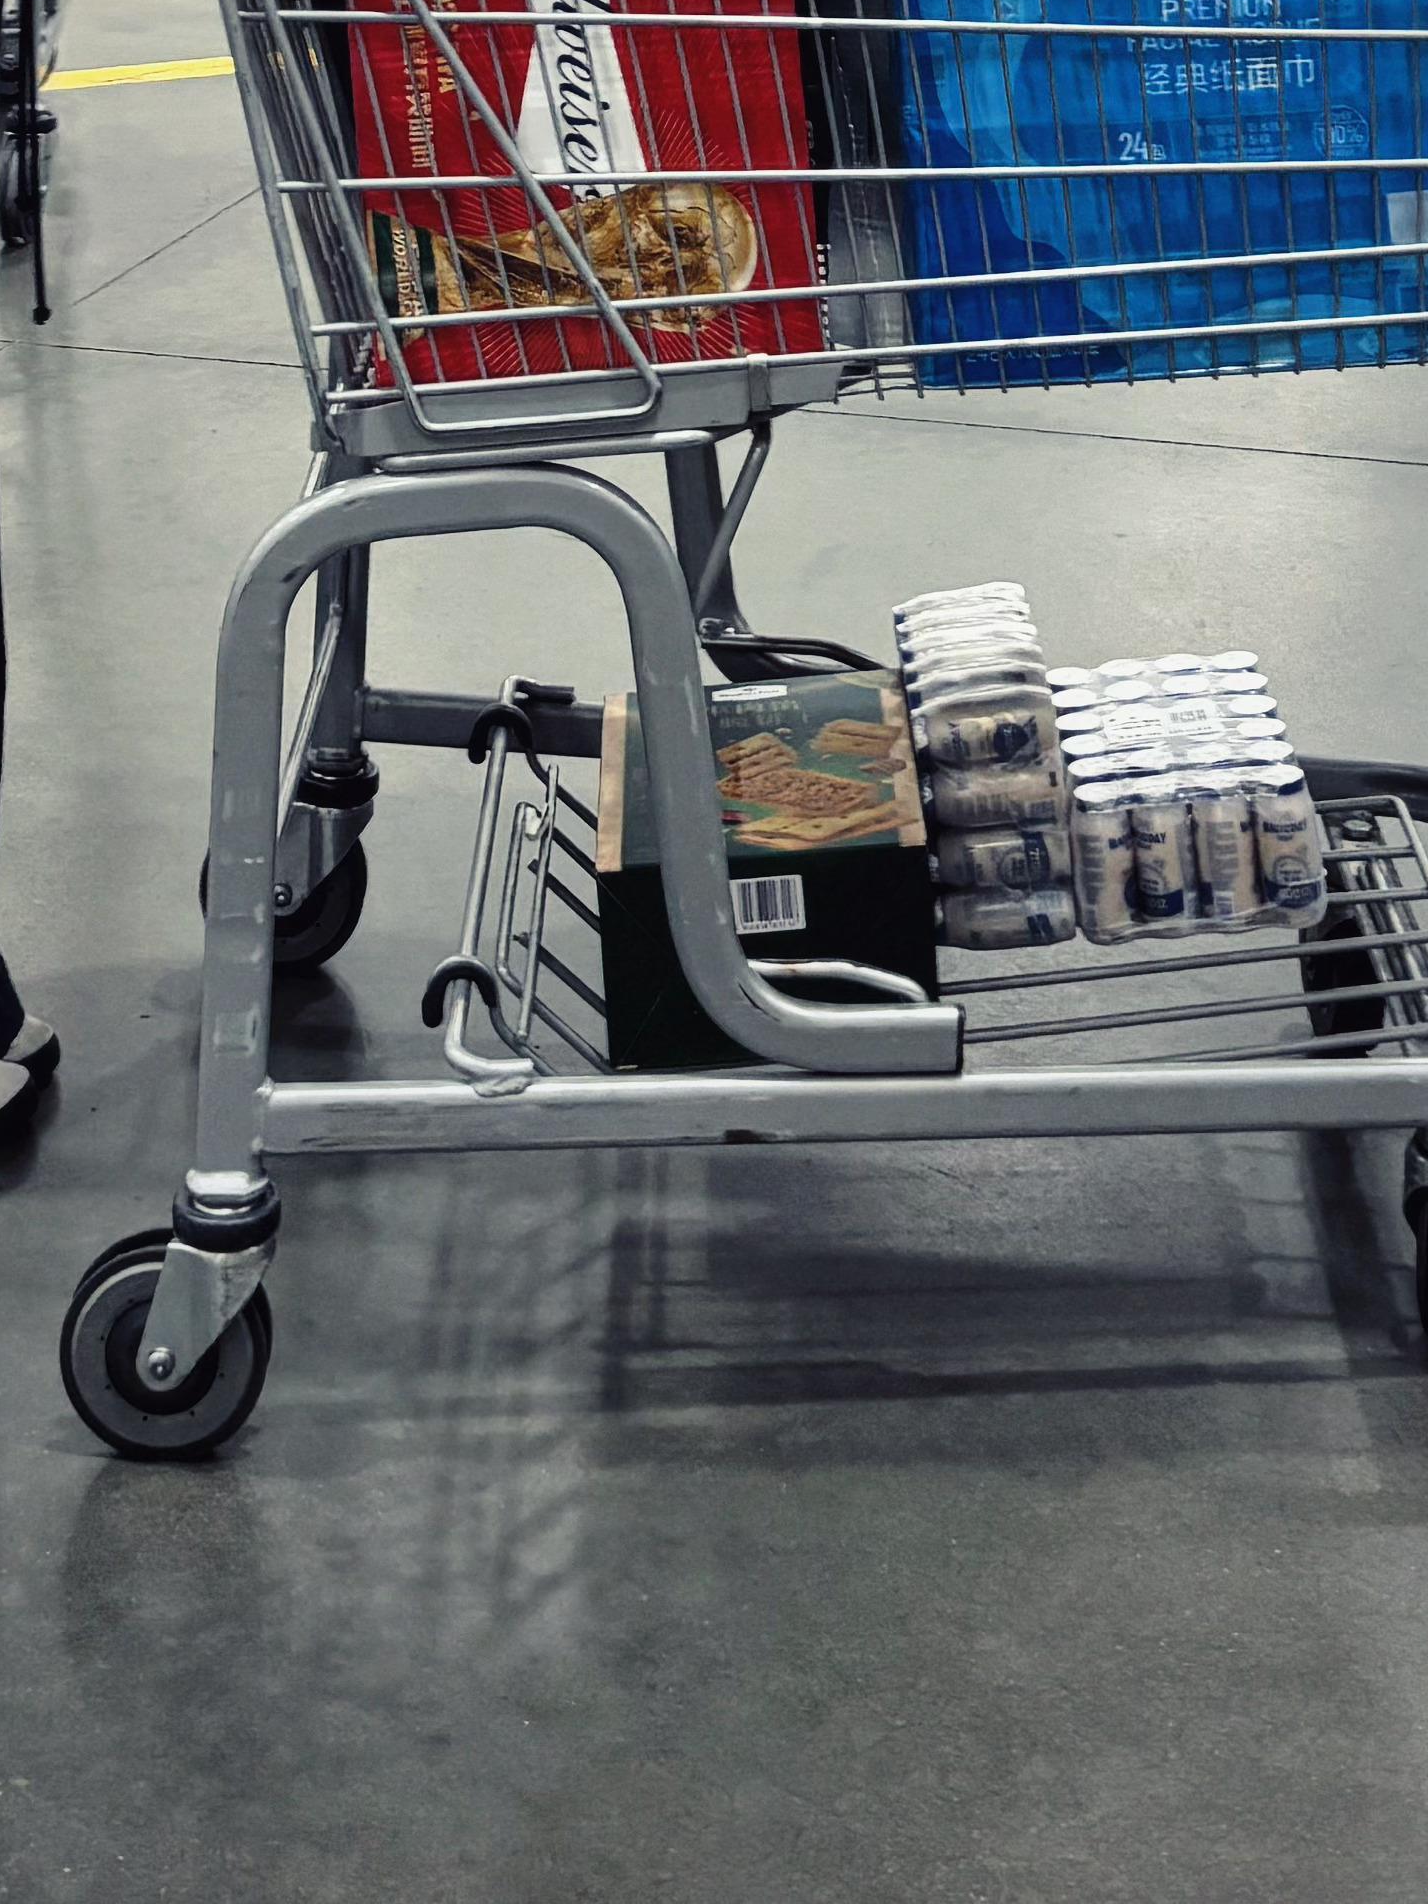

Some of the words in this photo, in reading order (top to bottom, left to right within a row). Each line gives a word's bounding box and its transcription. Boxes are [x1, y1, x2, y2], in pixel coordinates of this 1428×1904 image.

[1143, 55, 1315, 95] 经典纸面巾
